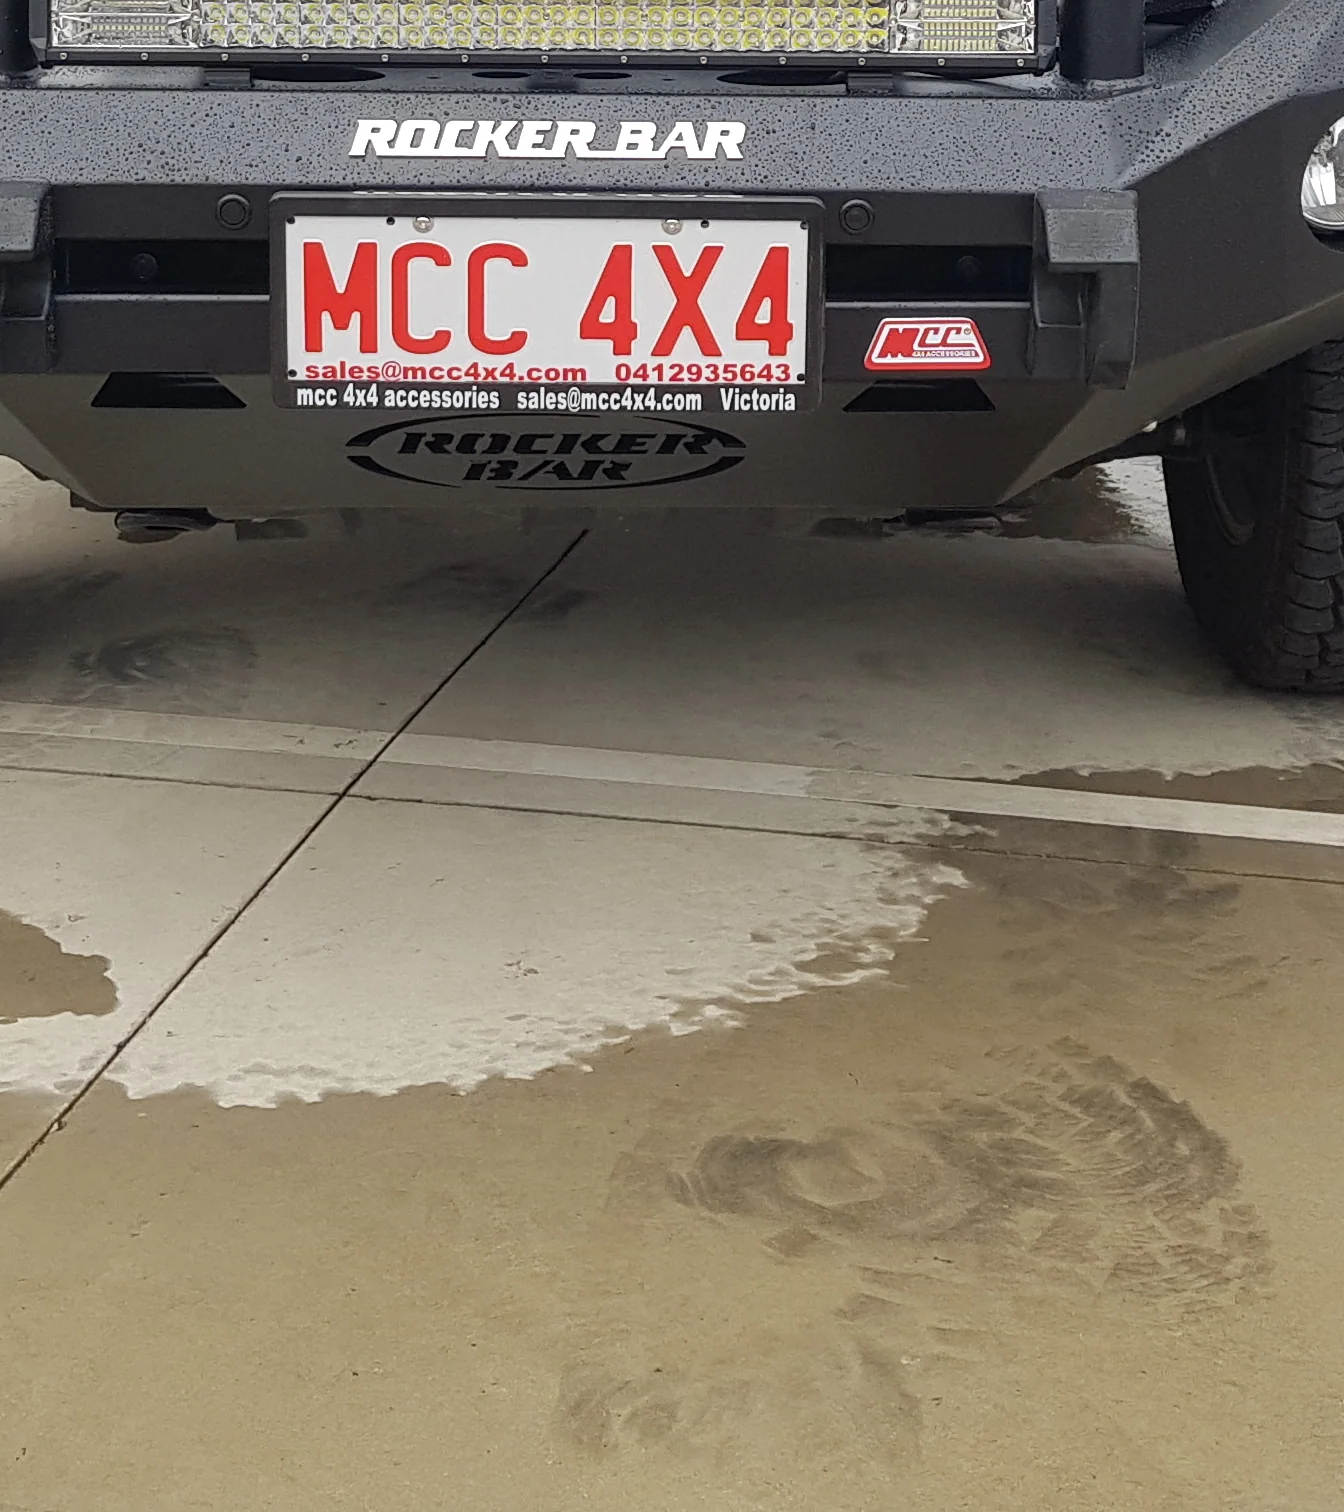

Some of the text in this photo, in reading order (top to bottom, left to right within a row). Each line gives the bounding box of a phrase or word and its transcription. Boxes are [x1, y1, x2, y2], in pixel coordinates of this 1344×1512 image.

[348, 119, 746, 160] ROCKER BAR
[303, 241, 794, 357] MCC 4X4
[876, 327, 975, 358] MCC
[305, 361, 791, 383] sales@mcc4x4.com 0412935643
[296, 383, 796, 412] mcc 4x4 accessories sales@mcc4x4.com Victoria
[398, 432, 712, 455] ROCKER
[462, 459, 633, 481] BAR
